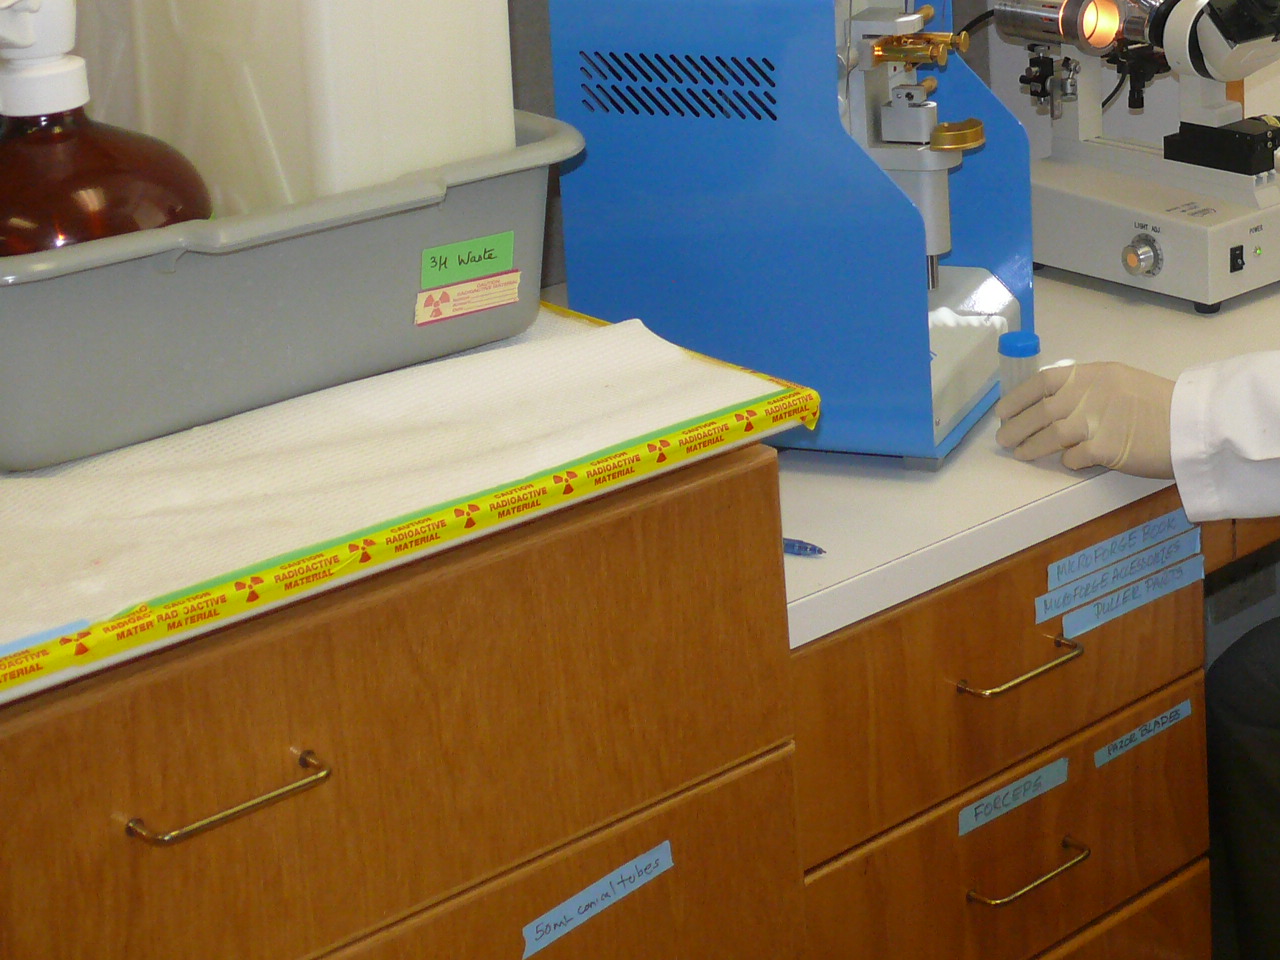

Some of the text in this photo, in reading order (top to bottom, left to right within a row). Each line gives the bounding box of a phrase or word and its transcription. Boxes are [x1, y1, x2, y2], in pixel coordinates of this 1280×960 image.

[458, 248, 497, 266] Waste
[764, 393, 814, 417] RADIOACTIVE
[772, 405, 810, 423] MATERIAL
[678, 423, 730, 447] RADIOACTIVE
[686, 435, 725, 454] MATERIAL
[586, 453, 641, 479] RADIOACTIVE
[594, 466, 636, 486] MATERIAL
[489, 486, 548, 512] RADIOACTIVE
[497, 499, 542, 519] MATERIAL
[385, 519, 448, 546] RADIOACTIVE
[394, 531, 440, 553] MATERIAL
[1142, 517, 1177, 544] BOOK
[273, 554, 341, 584] RADIOACTIVE
[284, 568, 334, 591] MATERIAL
[1094, 585, 1141, 619] PULLER
[1139, 709, 1181, 738] BLADES
[973, 775, 1042, 822] FORCEPS
[577, 880, 616, 916] conical
[617, 858, 660, 889] tubes
